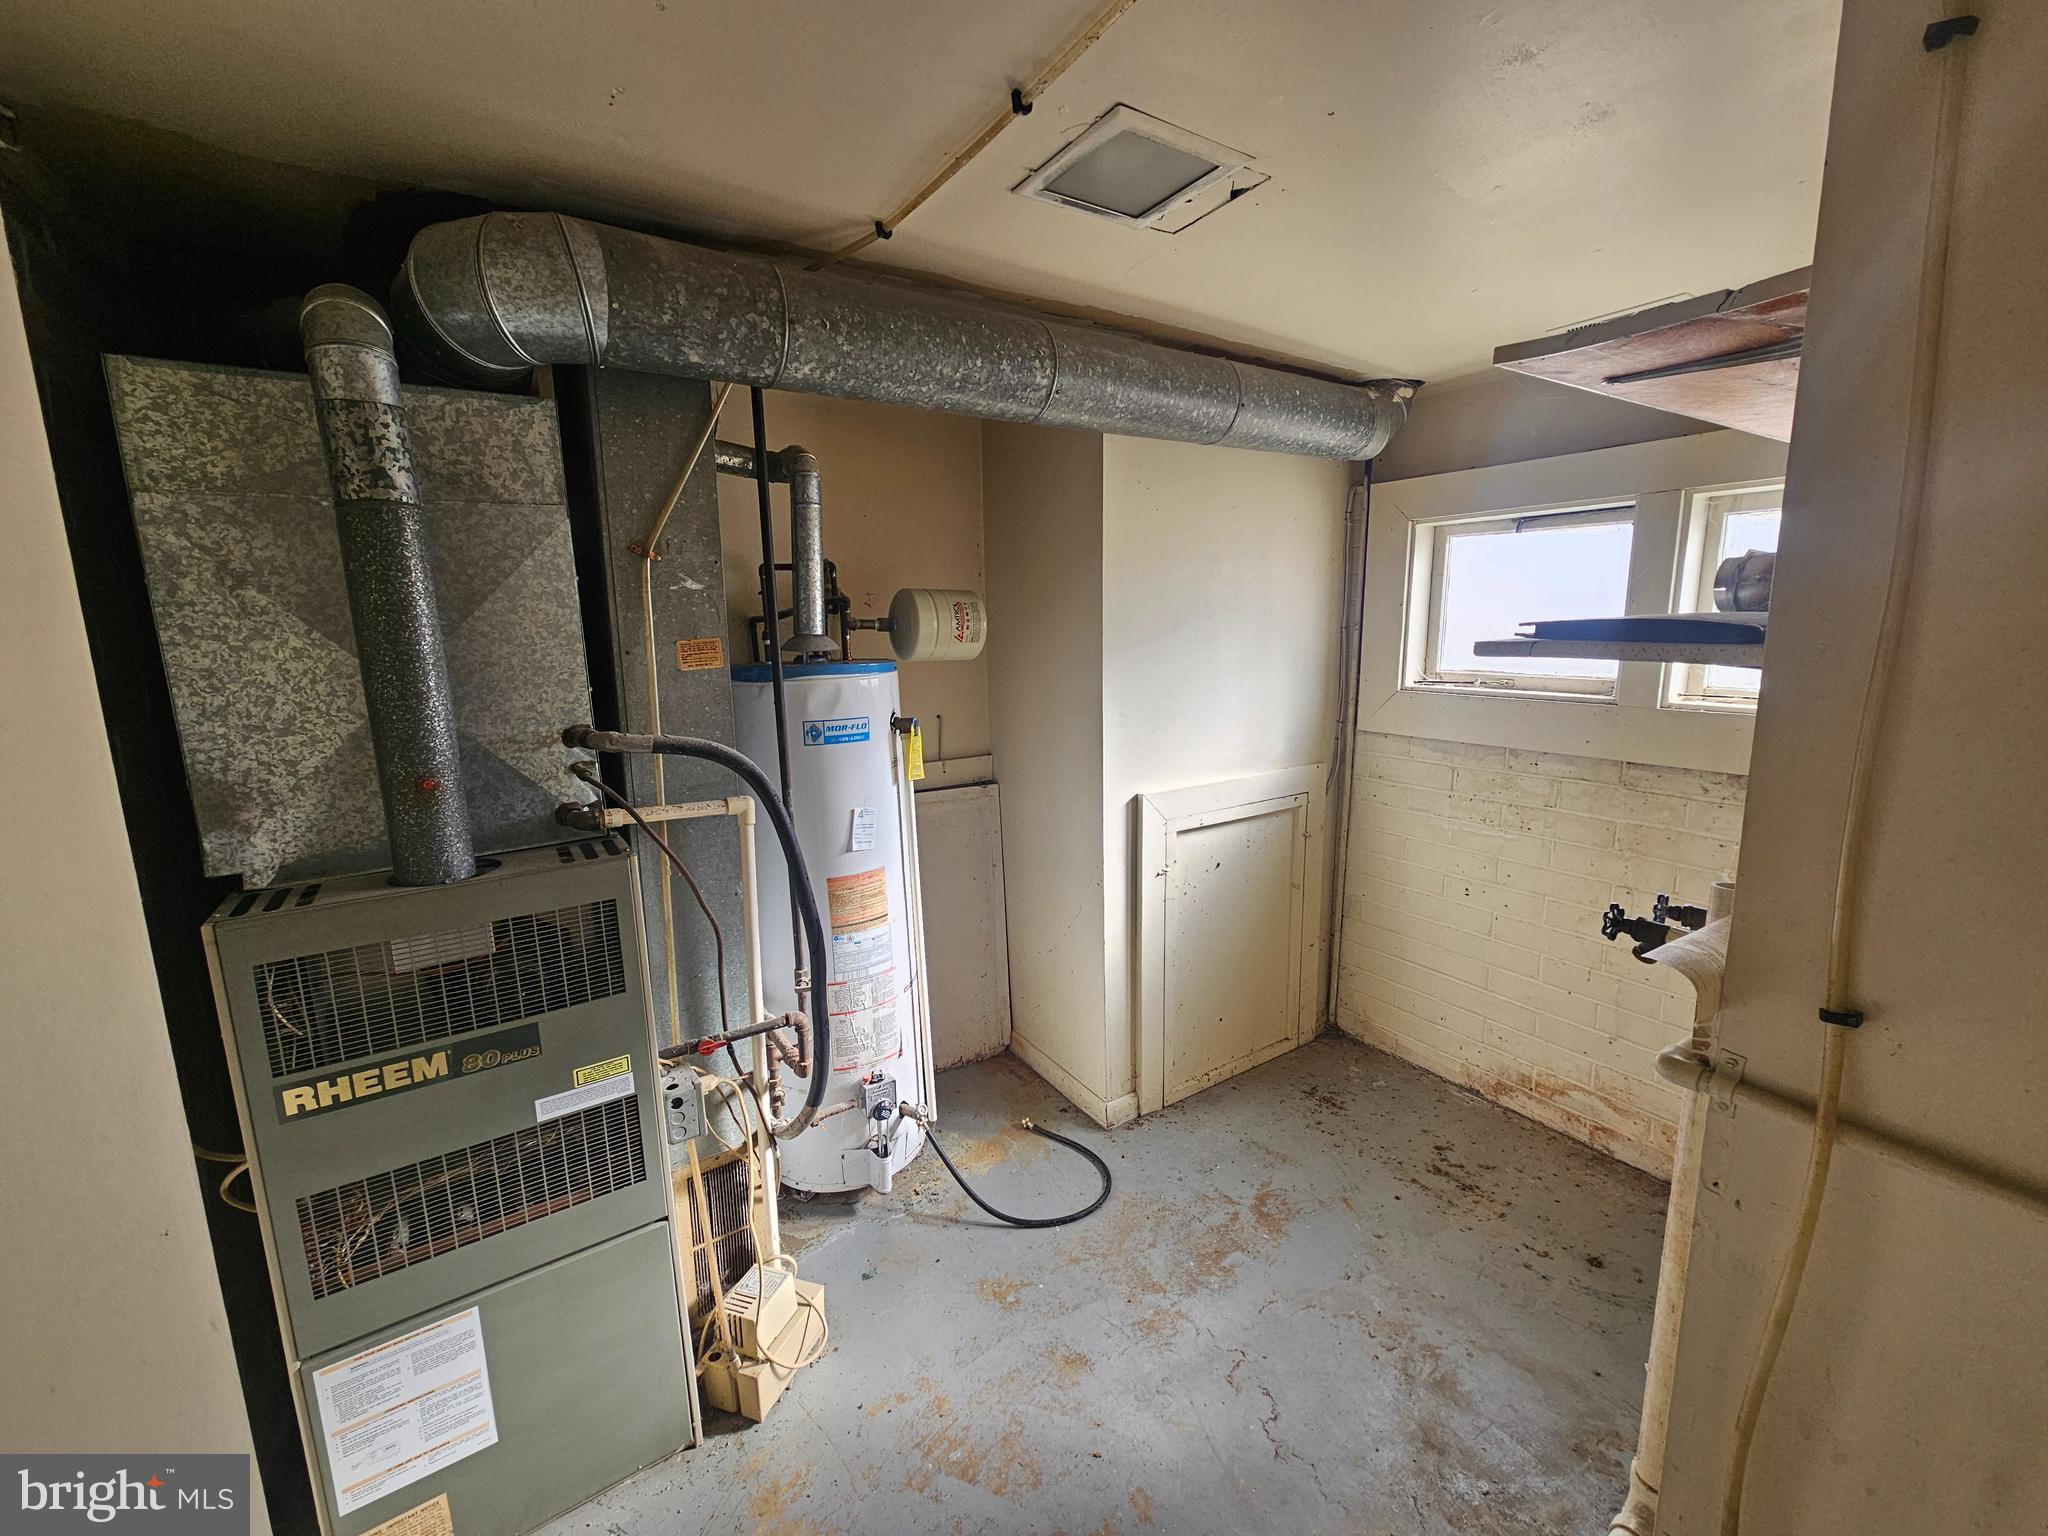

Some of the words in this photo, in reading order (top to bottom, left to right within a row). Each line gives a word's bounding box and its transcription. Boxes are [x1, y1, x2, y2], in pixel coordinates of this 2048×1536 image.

[826, 722, 867, 733] MOR-FLO
[282, 1051, 449, 1117] RHEEM
[461, 1049, 501, 1073] 80
[501, 1045, 541, 1064] PLUS
